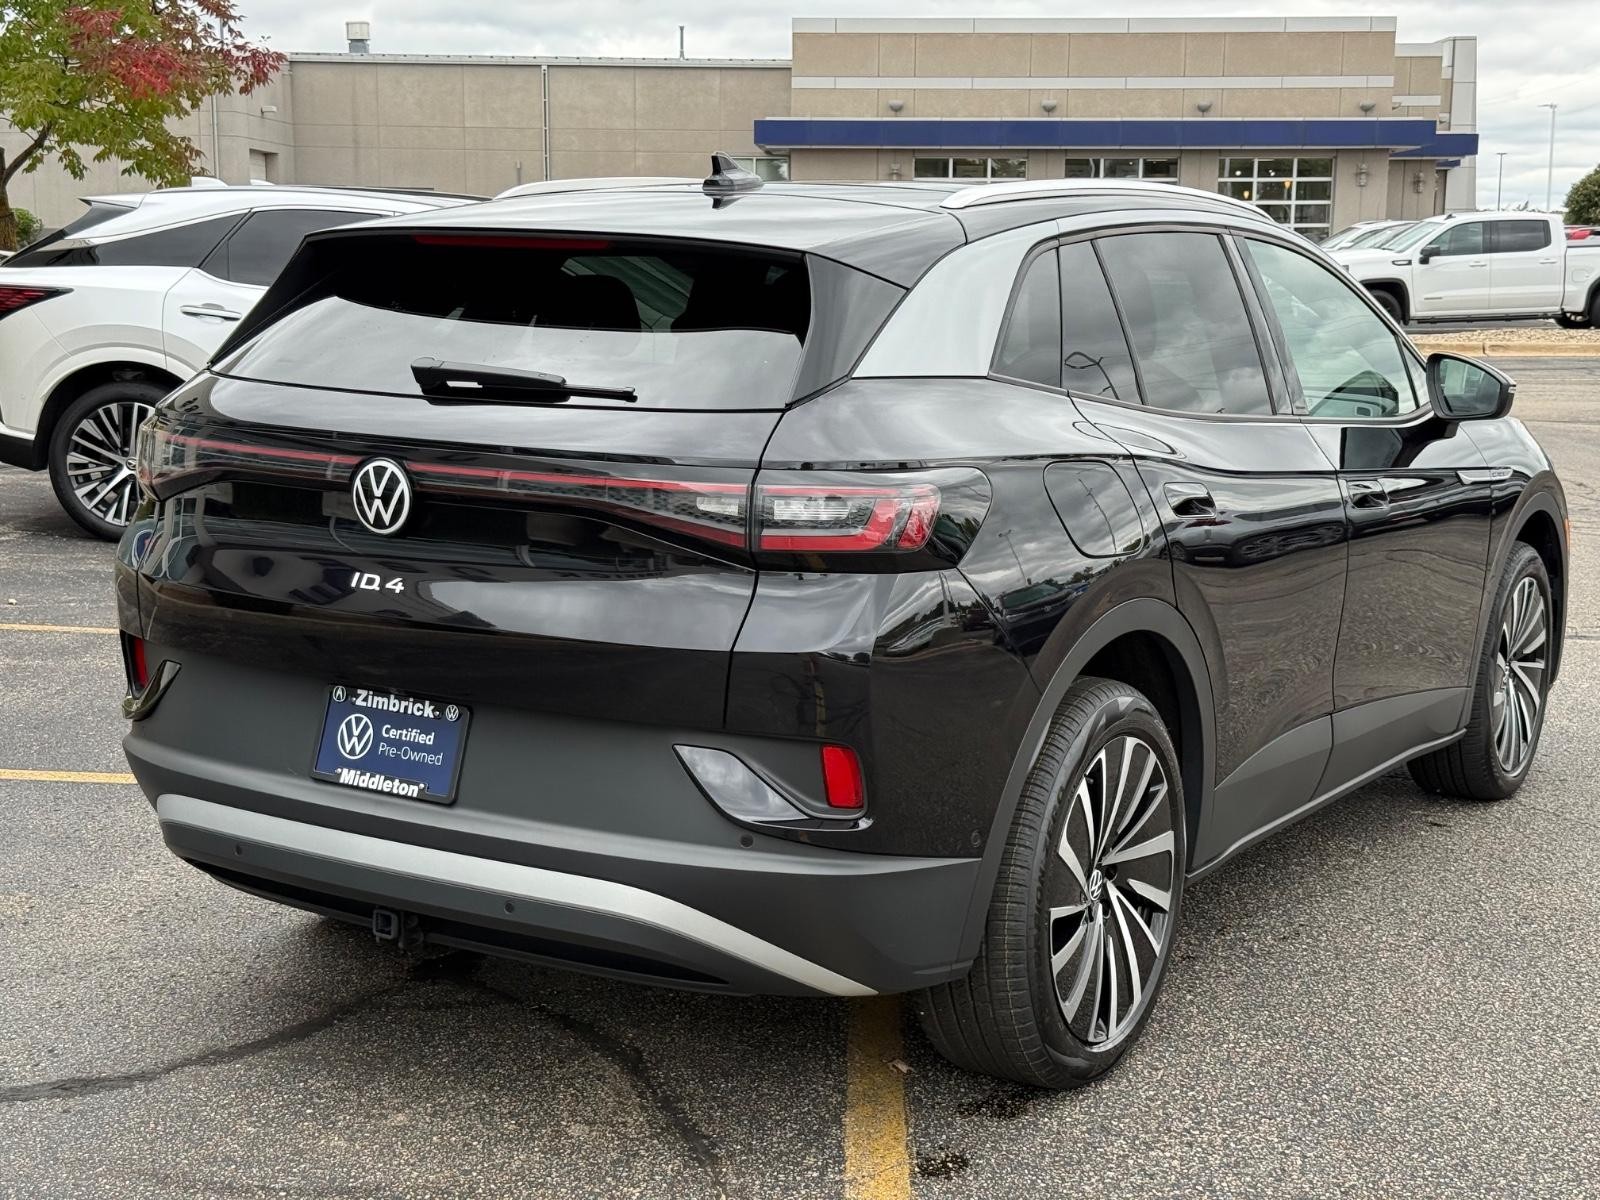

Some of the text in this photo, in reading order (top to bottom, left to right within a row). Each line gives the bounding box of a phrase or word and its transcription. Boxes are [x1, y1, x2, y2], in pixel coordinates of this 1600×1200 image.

[355, 689, 435, 718] Zimbrick
[382, 724, 435, 745] Certified
[378, 742, 443, 766] Pre-Owned
[339, 768, 419, 798] Middleton
